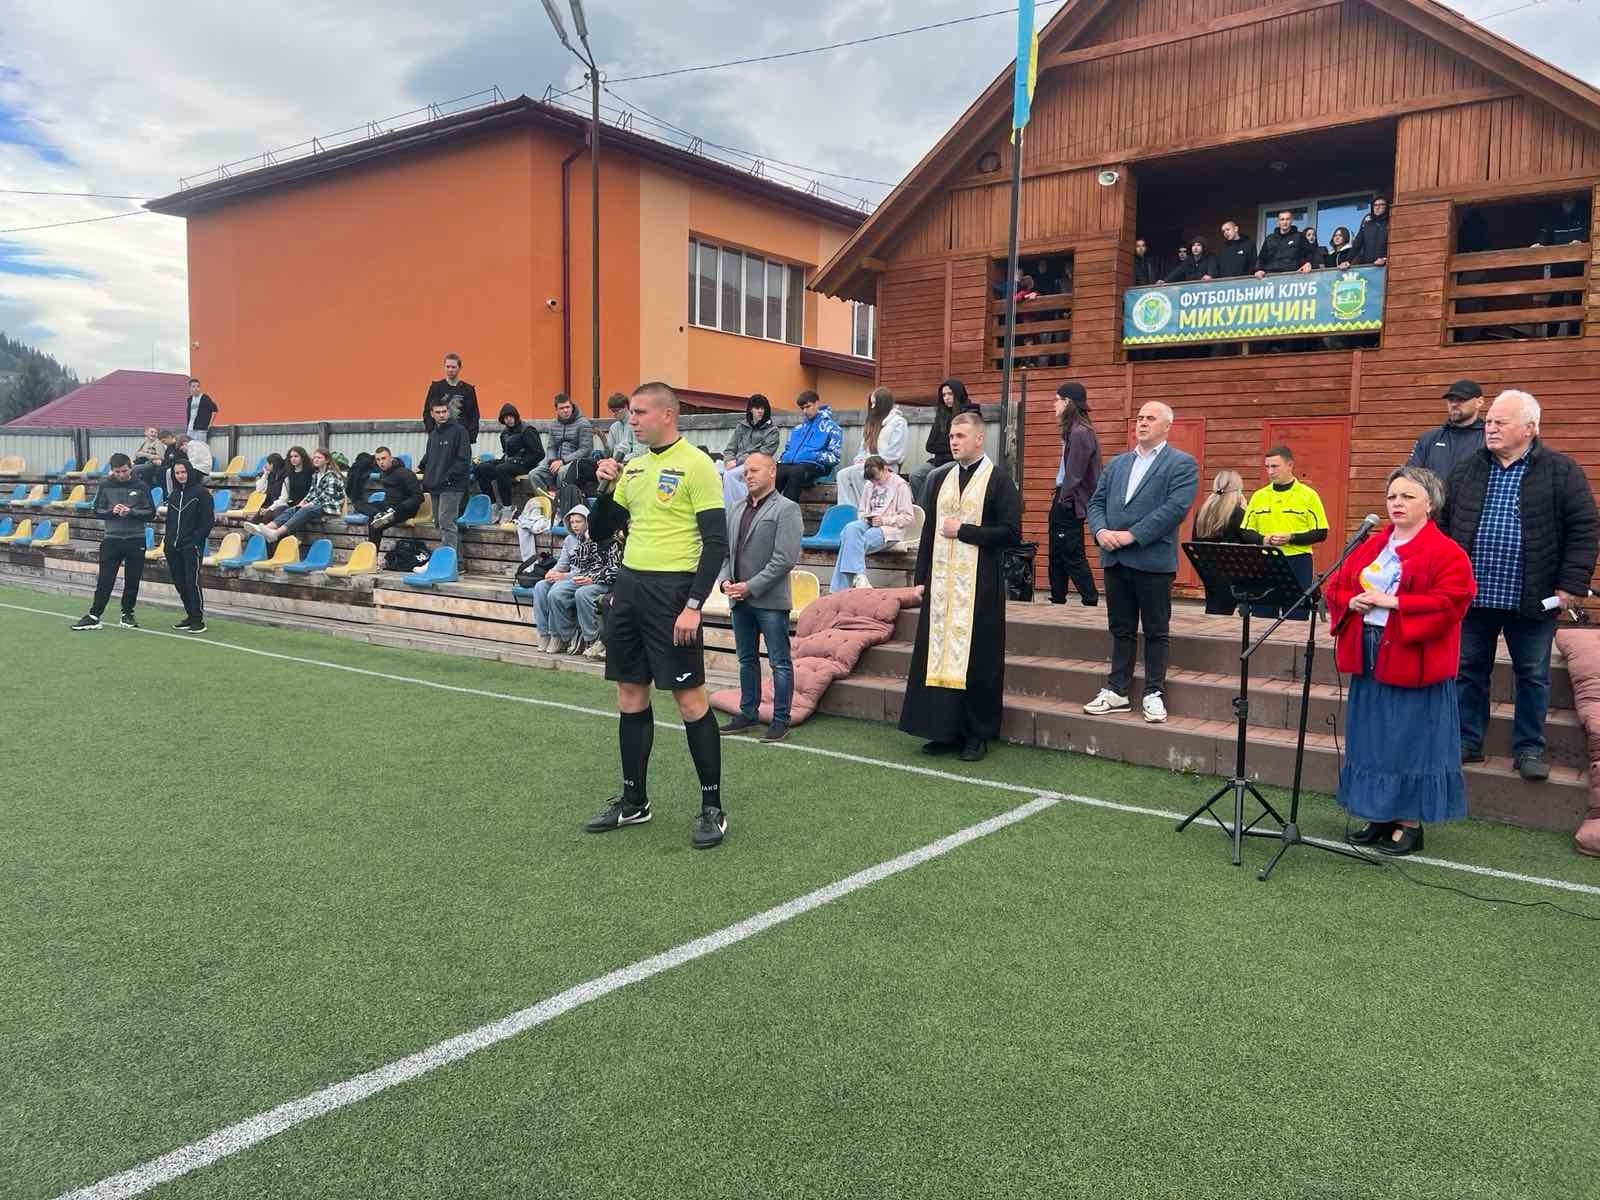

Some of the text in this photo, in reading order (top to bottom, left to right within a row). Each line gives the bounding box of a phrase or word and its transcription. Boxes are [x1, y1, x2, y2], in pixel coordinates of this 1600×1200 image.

[1180, 280, 1318, 307] ФУТБОЛЬНИЙ КЛУБ
[1179, 300, 1316, 329] МИКУЛИЧИН
